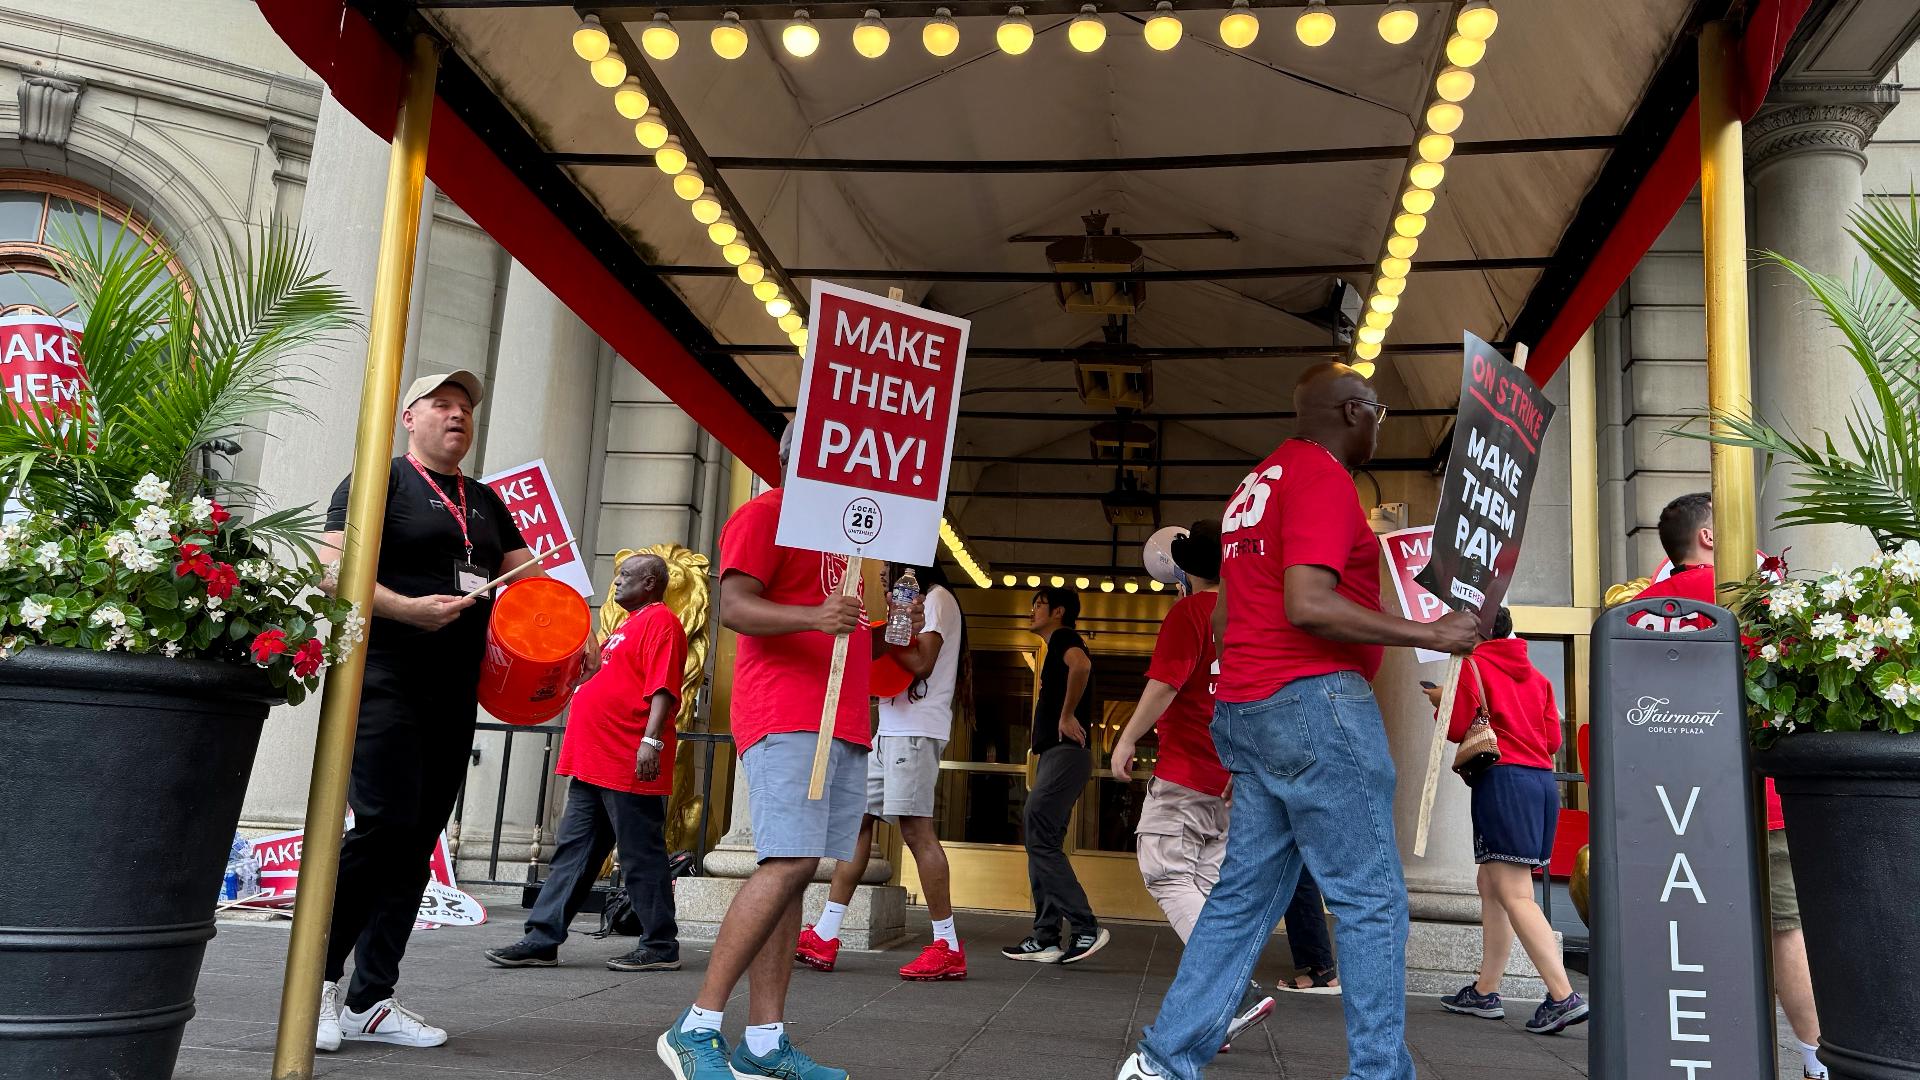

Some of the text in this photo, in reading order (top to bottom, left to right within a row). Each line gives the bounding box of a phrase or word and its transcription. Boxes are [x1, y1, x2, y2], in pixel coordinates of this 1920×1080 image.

[0, 333, 79, 367] AKE
[834, 309, 945, 372] MAKE
[0, 373, 80, 403] HEM
[828, 362, 936, 421] THEM
[1472, 353, 1544, 440] ON STRIKE
[817, 419, 927, 486] PAY!
[1467, 427, 1523, 498] MAKE
[500, 476, 538, 505] KE
[852, 505, 877, 514] LOCAL
[1222, 465, 1283, 533] 26
[1461, 467, 1516, 538] THEM
[852, 513, 873, 528] 26
[1454, 514, 1503, 578] PAY.
[1627, 696, 1724, 726] Fairmont
[1648, 726, 1704, 735] COPLEY PLAZA
